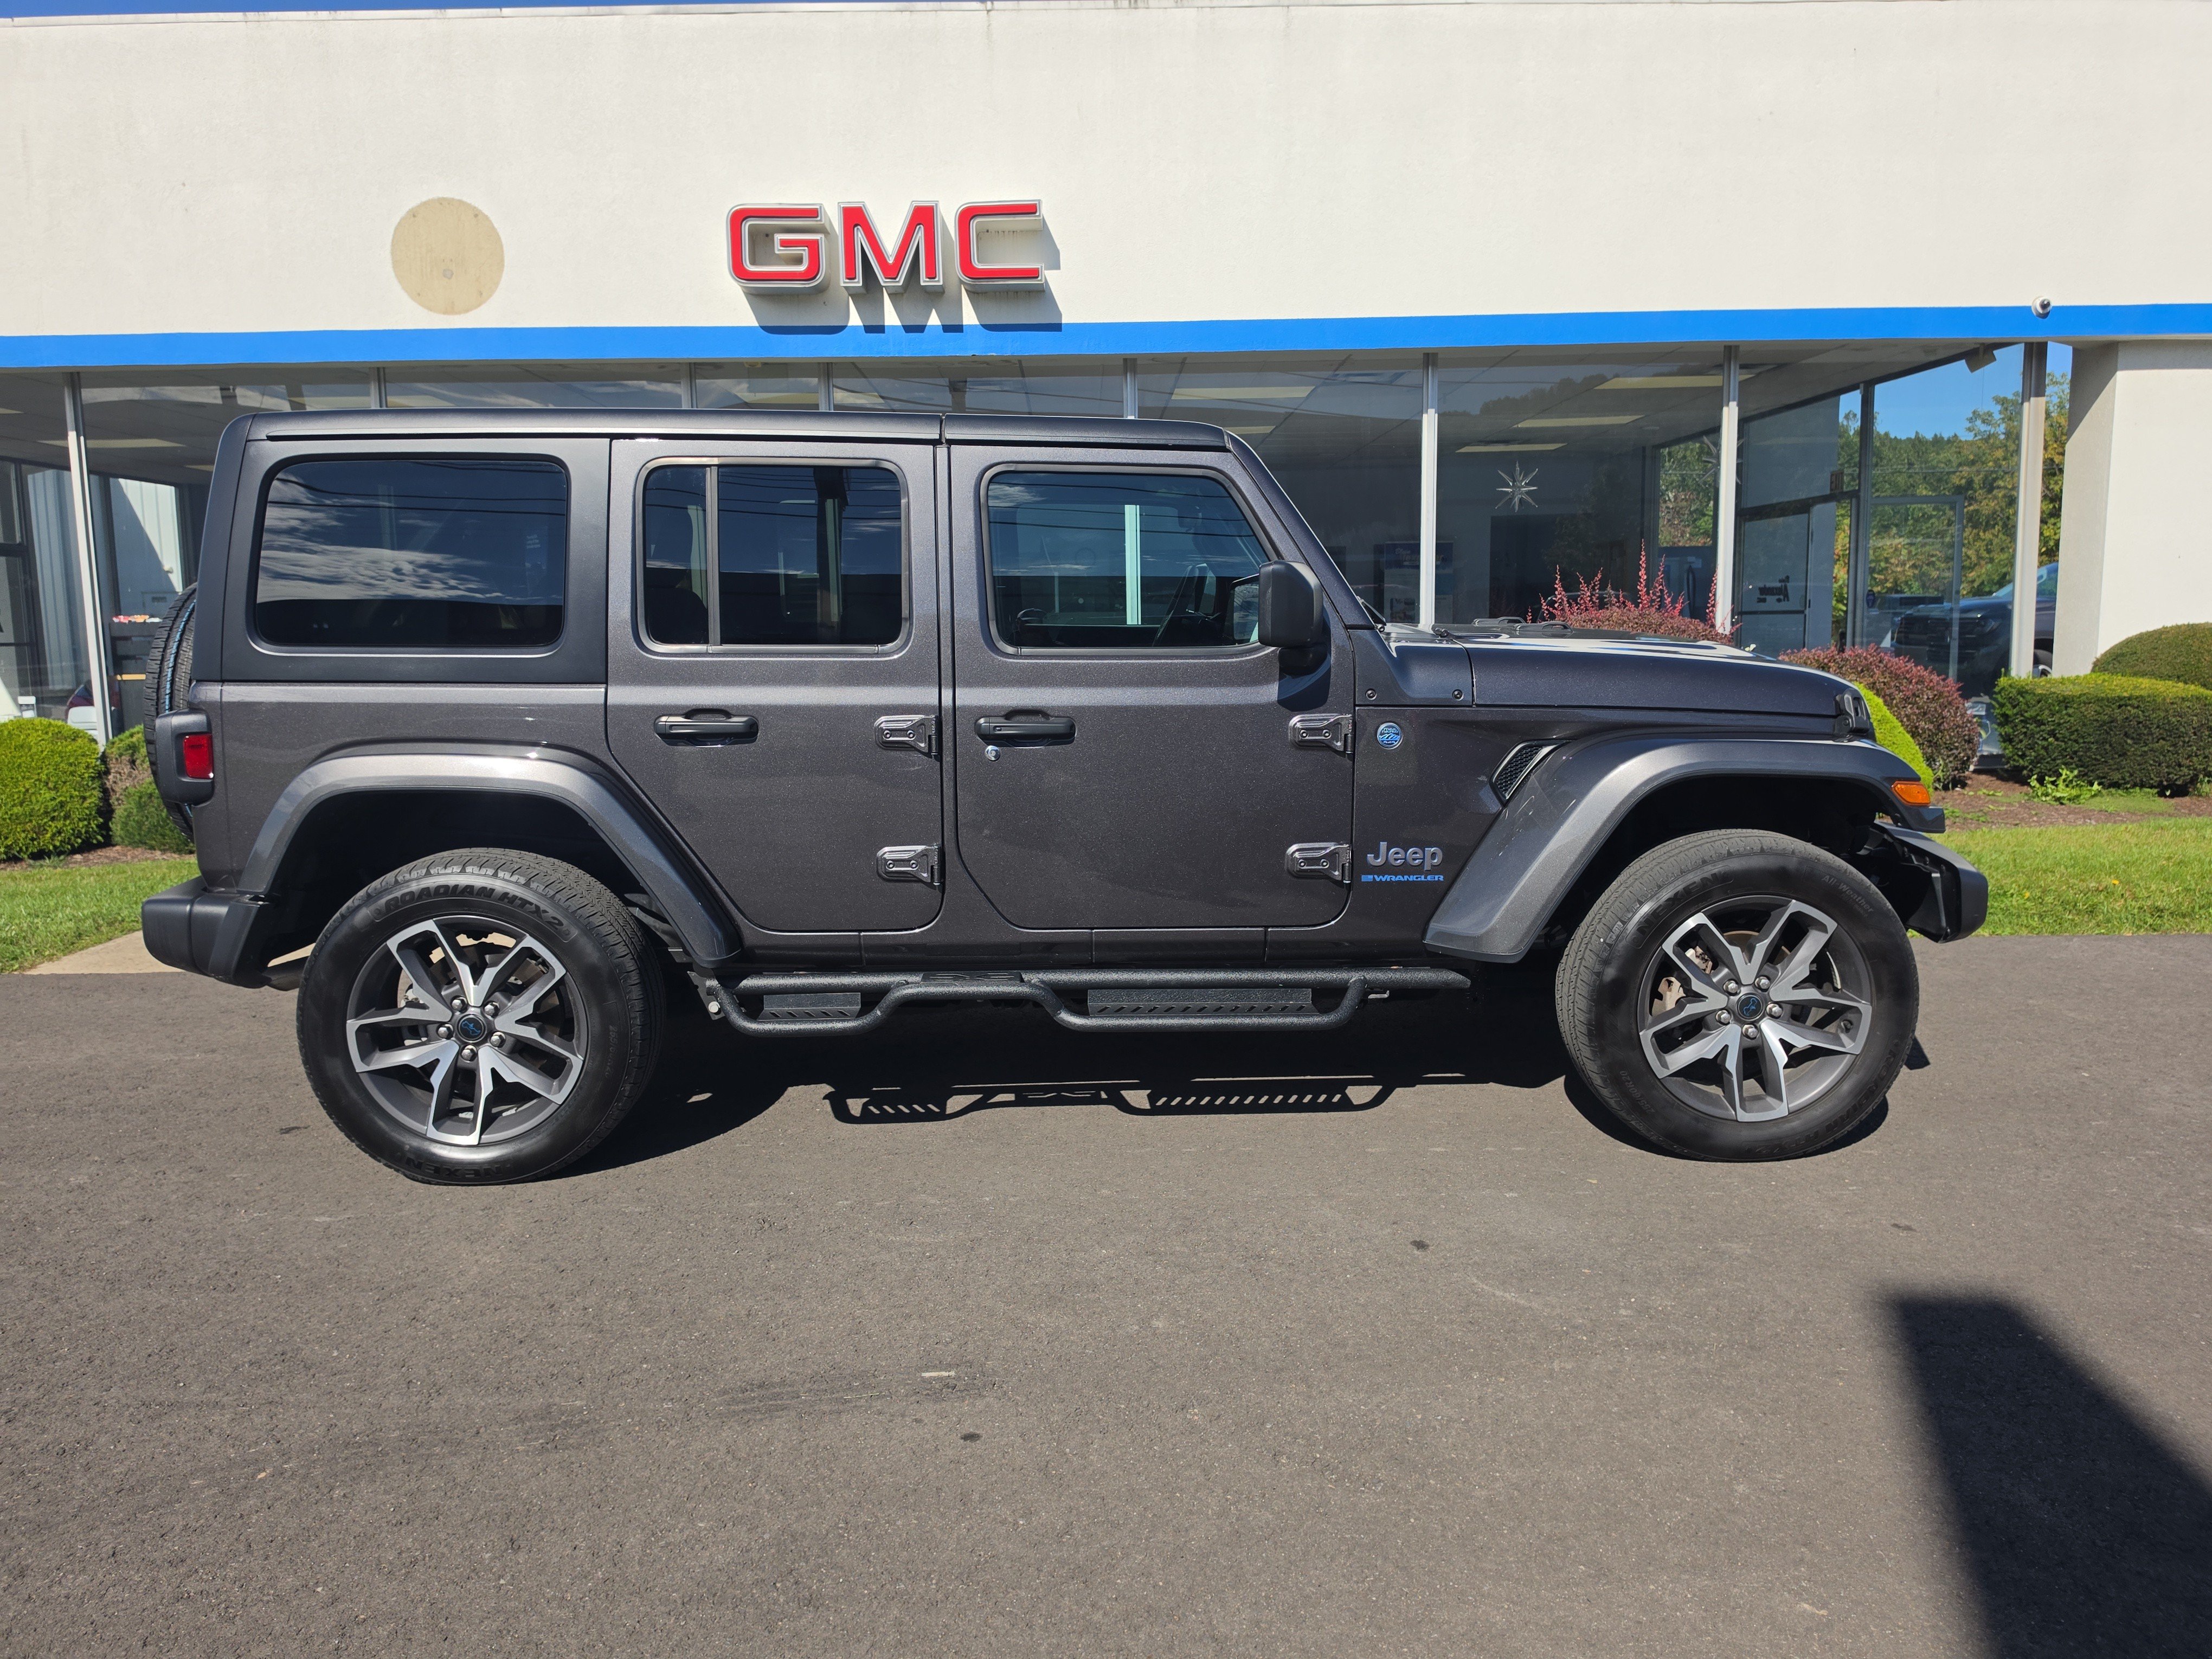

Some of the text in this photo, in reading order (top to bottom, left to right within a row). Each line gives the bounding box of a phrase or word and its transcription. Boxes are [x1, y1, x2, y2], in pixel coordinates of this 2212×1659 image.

[725, 199, 1045, 287] GMC
[1367, 841, 1443, 871] Jeep
[384, 884, 496, 912] ROADIAN
[1636, 872, 1721, 936] NEXEN
[405, 1156, 504, 1178] NEXEN
